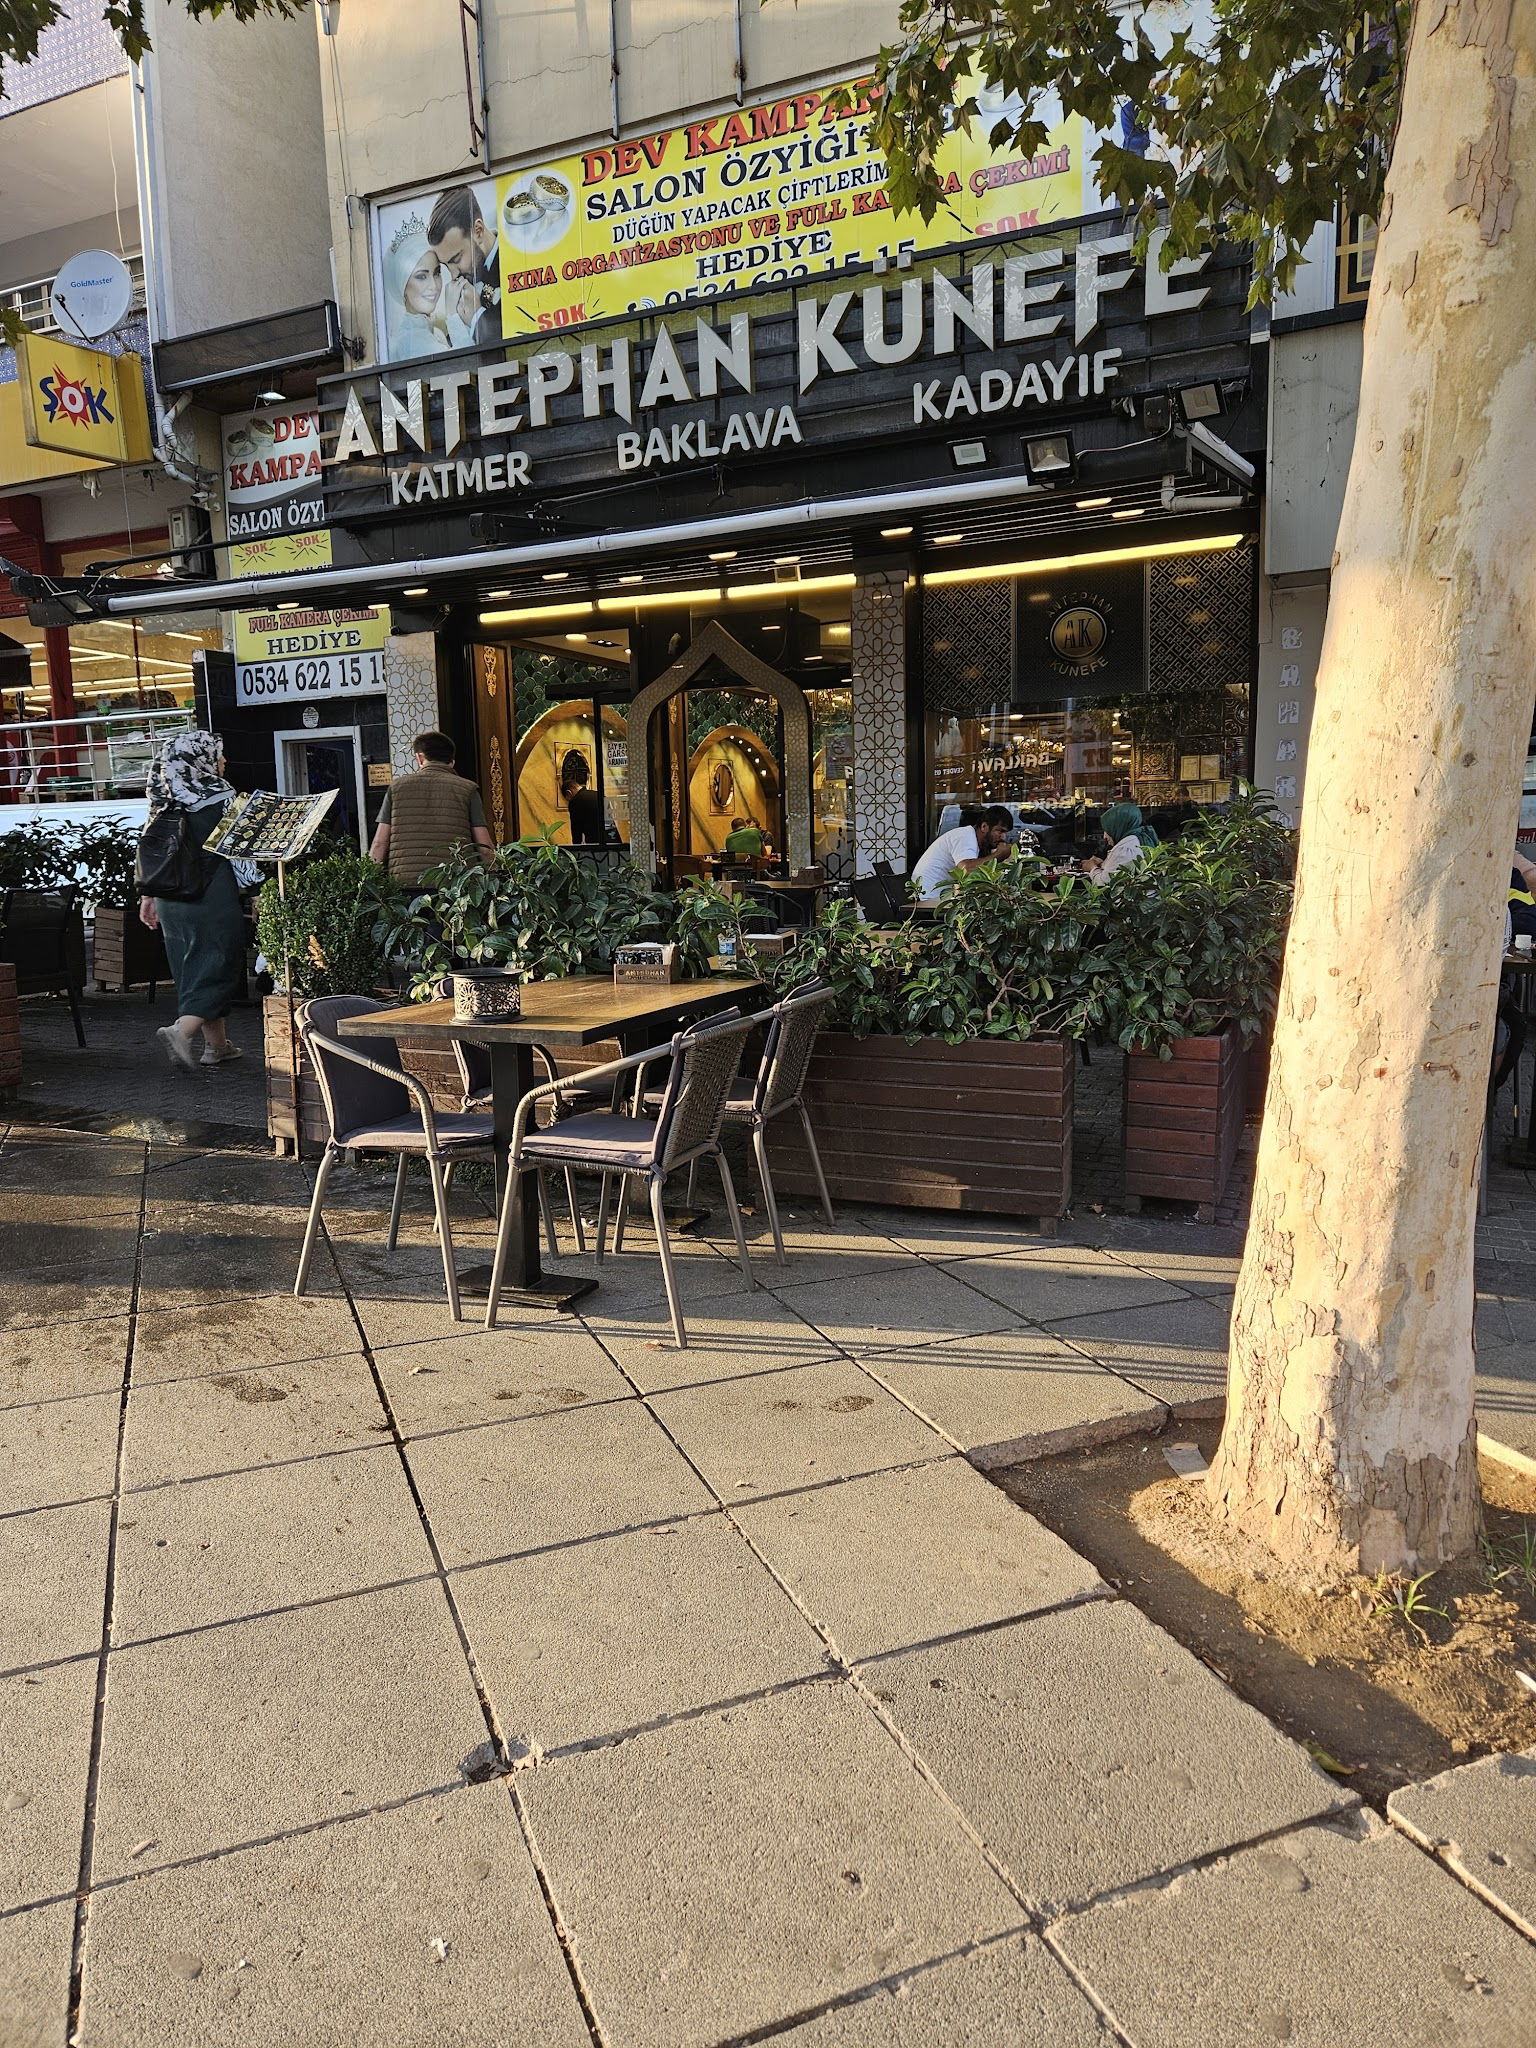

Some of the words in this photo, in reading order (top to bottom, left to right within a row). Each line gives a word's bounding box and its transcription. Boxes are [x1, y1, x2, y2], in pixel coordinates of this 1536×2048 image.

[582, 132, 673, 187] DEV
[684, 68, 930, 162] KAMPAN
[586, 167, 706, 221] SALON
[613, 212, 675, 244] DÜĞÜN
[682, 190, 771, 226] YAPACAK
[777, 160, 889, 209] ÇİFTLERİM
[508, 266, 557, 293] KINA
[562, 223, 742, 279] ORGANİZASYONU
[748, 214, 780, 239] VE
[786, 199, 847, 231] FULL
[852, 171, 961, 216] KAA
[695, 230, 832, 279] HEDİYE
[70, 277, 113, 288] GoldMaster
[334, 311, 755, 461] ANTEPHAN
[799, 220, 1214, 397] KÜNEFE
[39, 375, 115, 425] ŞOK
[391, 450, 534, 506] KATMER
[616, 405, 804, 471] BAKLAVA
[912, 347, 1123, 424] KADAYIF
[229, 450, 322, 491] KAMPA
[230, 506, 283, 536] SALON
[295, 534, 321, 548] SOK
[245, 543, 268, 556] SOK
[249, 615, 278, 633] FULL
[280, 610, 331, 629] KAMERA
[1064, 617, 1093, 648] AK
[267, 629, 361, 655] HEDİYE
[242, 664, 289, 696] 0534
[295, 660, 331, 691] 622
[339, 656, 362, 687] 15
[608, 750, 628, 759] GARS
